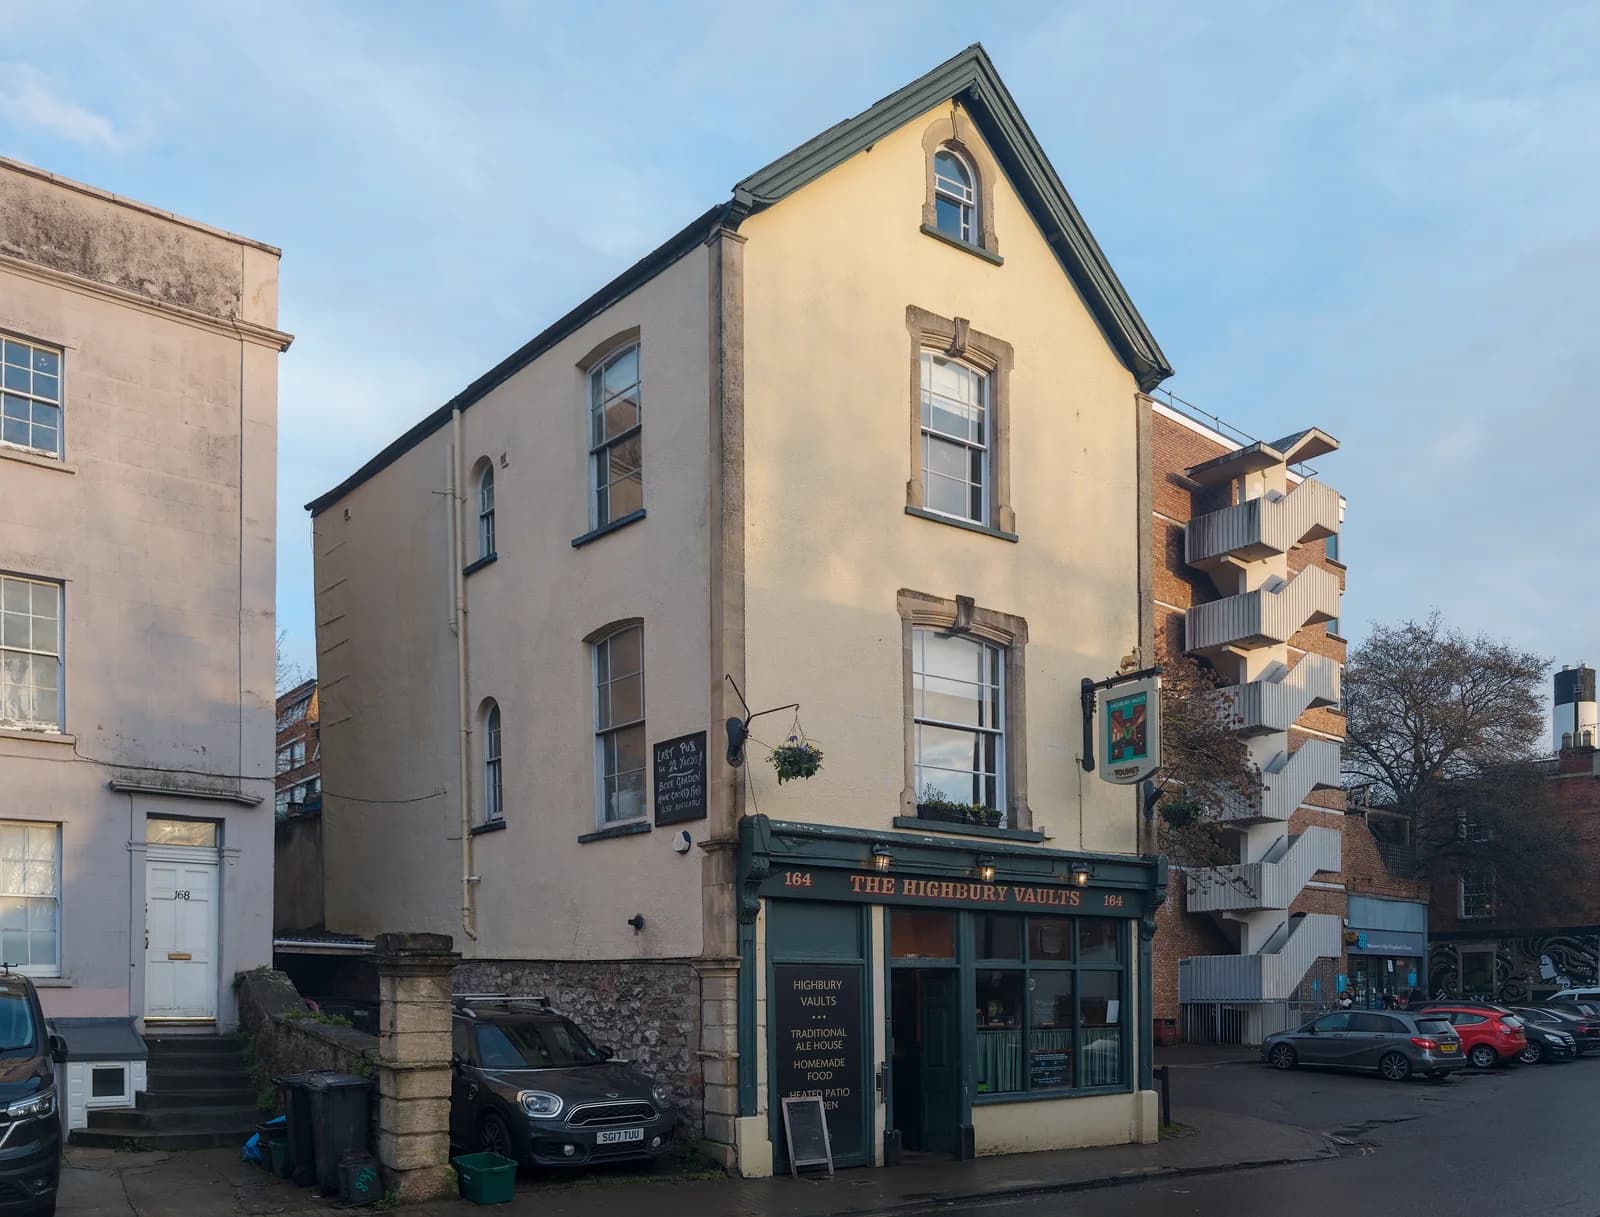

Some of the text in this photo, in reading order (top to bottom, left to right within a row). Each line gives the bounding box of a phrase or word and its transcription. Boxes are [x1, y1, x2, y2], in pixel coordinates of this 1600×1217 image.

[657, 740, 696, 762] LAST PUB
[784, 871, 812, 887] 164
[174, 890, 190, 901] 168
[850, 875, 1080, 906] THE HIGHBURY VAULTS
[1103, 895, 1123, 907] 164
[793, 980, 842, 990] HIGHBURY
[800, 996, 837, 1006] VAULTS
[790, 1028, 848, 1039] TRADITIONAL
[796, 1040, 843, 1051] ALE HOUSE
[793, 1058, 846, 1069] HOMEMADE
[807, 1071, 833, 1081] FOOD
[826, 1087, 850, 1098] PATIO
[602, 1129, 640, 1143] SG17 TUU
